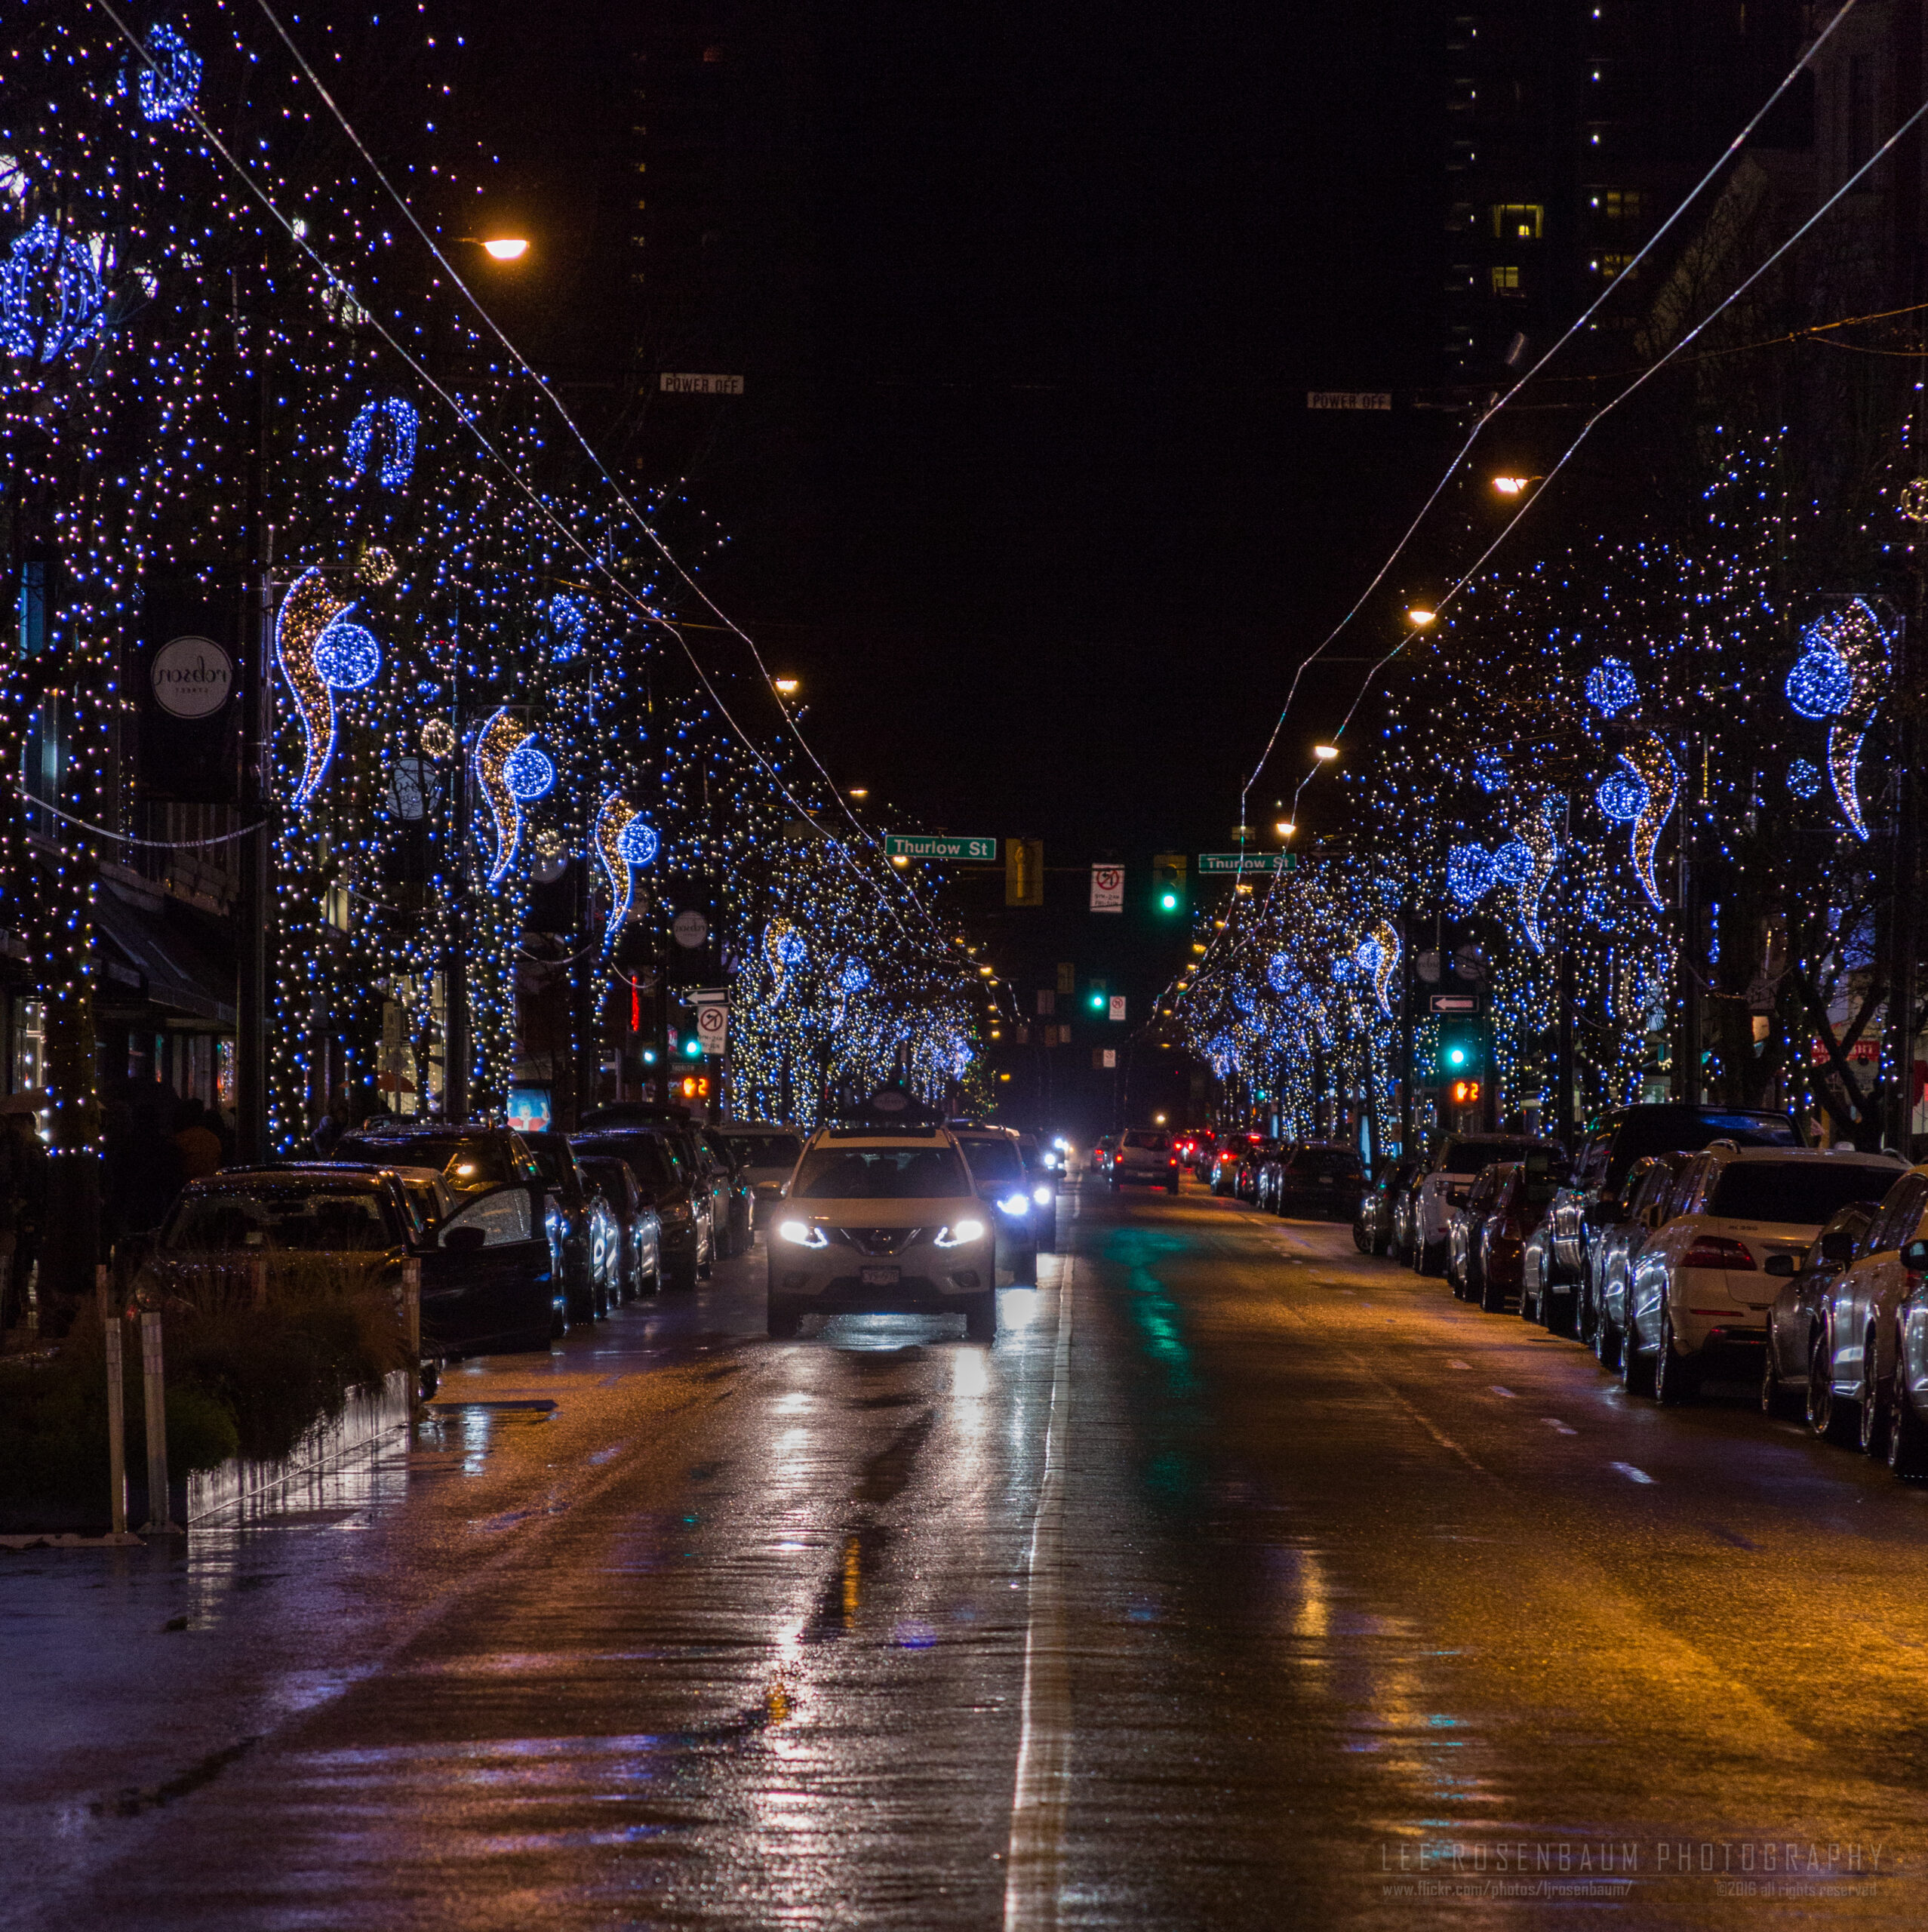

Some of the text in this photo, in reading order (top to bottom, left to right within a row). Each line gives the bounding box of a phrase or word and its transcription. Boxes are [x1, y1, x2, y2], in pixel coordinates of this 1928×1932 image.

[665, 377, 738, 393] POWER OFF
[1313, 394, 1384, 408] POWER OFF
[893, 838, 988, 857] Thurlow St
[1273, 857, 1290, 869] St
